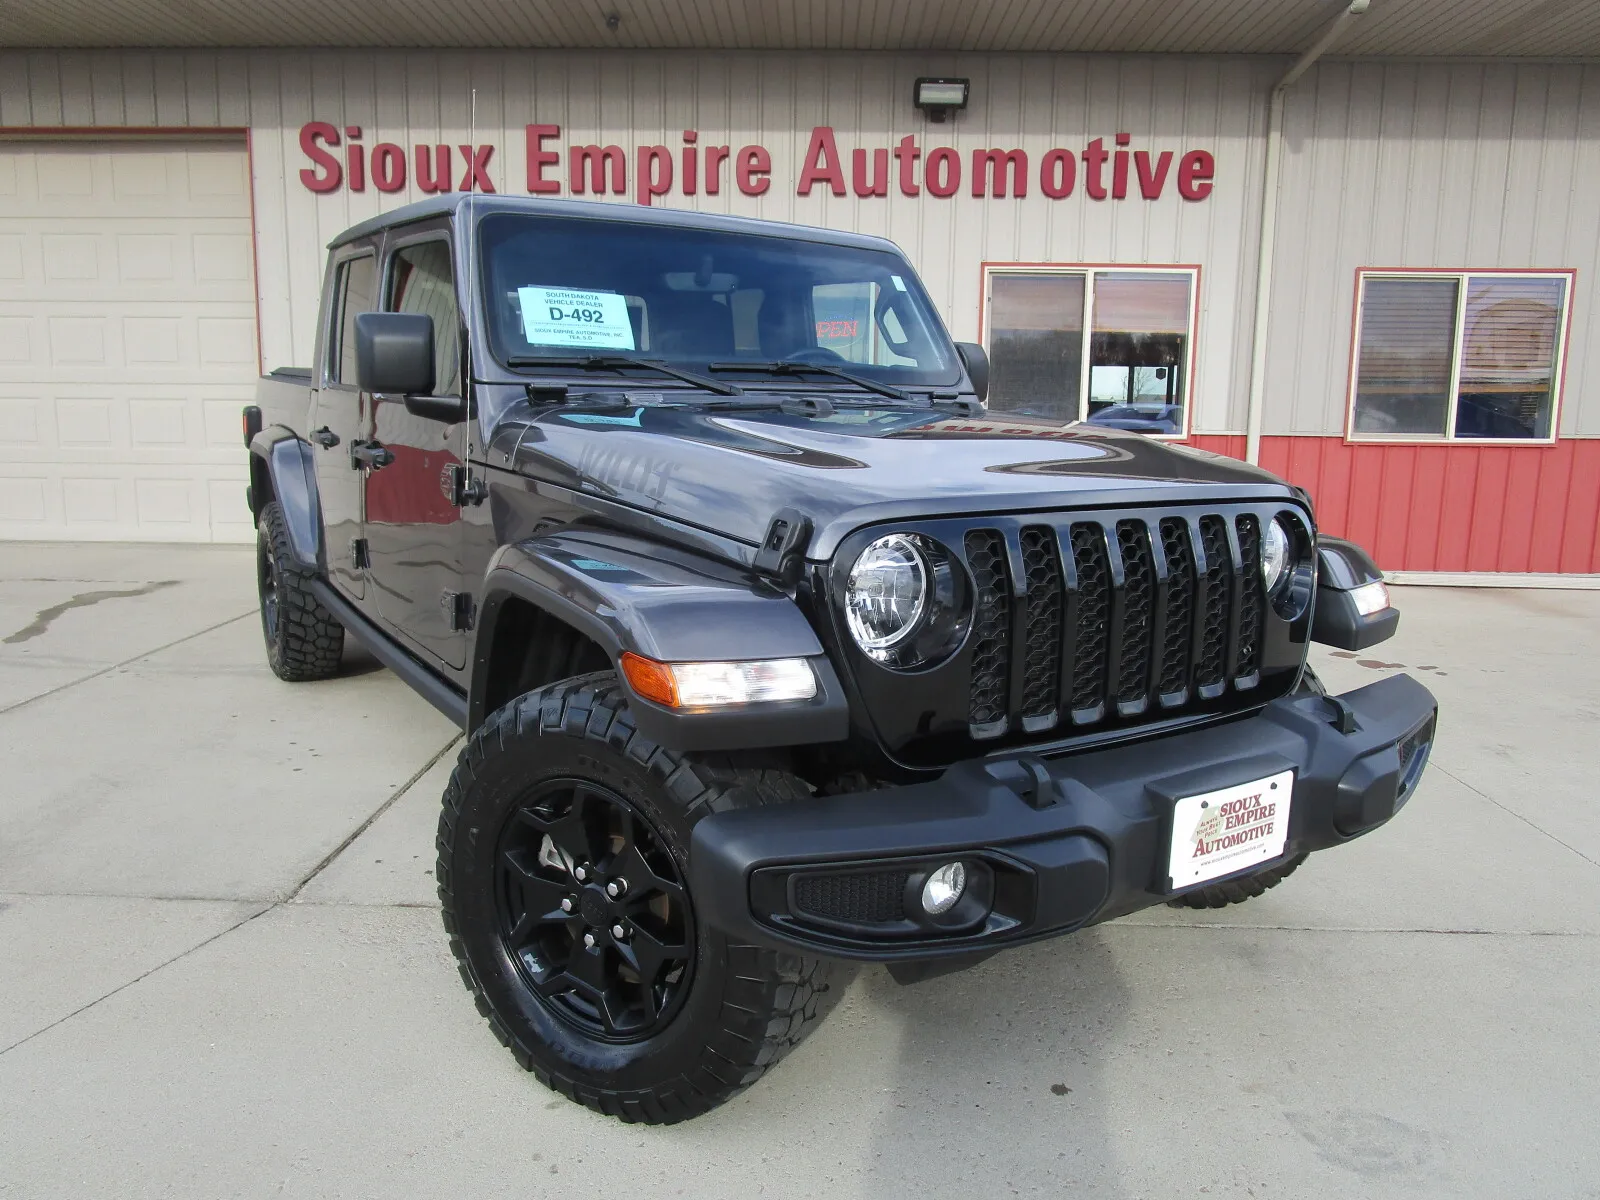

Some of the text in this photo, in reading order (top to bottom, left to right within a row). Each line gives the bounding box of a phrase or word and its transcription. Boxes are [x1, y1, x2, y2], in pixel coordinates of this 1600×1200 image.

[298, 121, 1215, 206] Sioux Empire Automotive
[544, 298, 603, 308] VEHICLE DEALER
[545, 291, 599, 301] SOUTH DAKOTA
[549, 306, 604, 324] D-492
[816, 321, 857, 338] PEN
[1220, 794, 1262, 817] SIOUX
[1225, 803, 1275, 829] EMPIRE
[1192, 823, 1273, 857] AUTOMOTIVE
